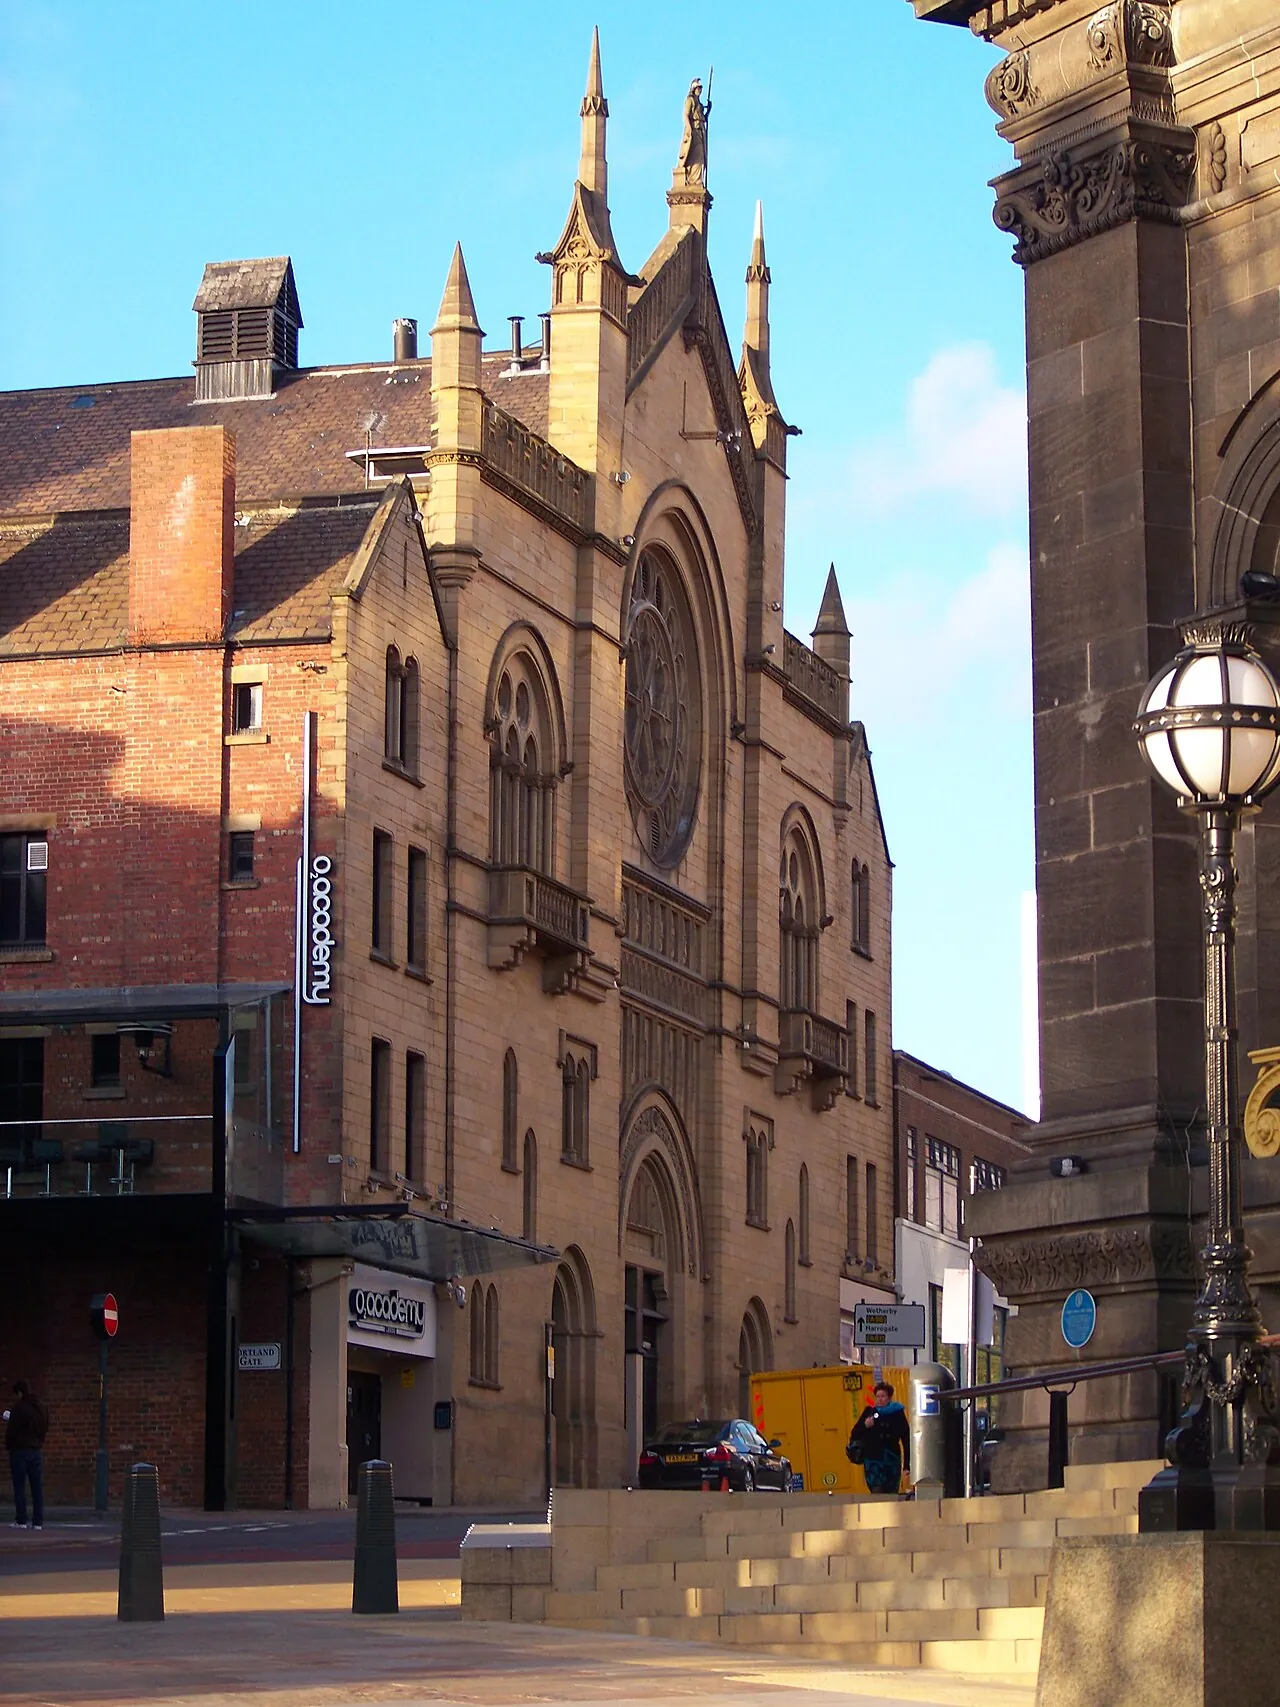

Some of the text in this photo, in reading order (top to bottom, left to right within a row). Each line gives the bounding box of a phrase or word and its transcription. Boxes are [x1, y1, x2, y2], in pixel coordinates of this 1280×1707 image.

[866, 1307, 897, 1315] Wetherby
[866, 1325, 898, 1333] Harrogate
[239, 1348, 275, 1356] ORTLAND
[239, 1357, 263, 1366] GATE
[920, 1389, 936, 1411] P
